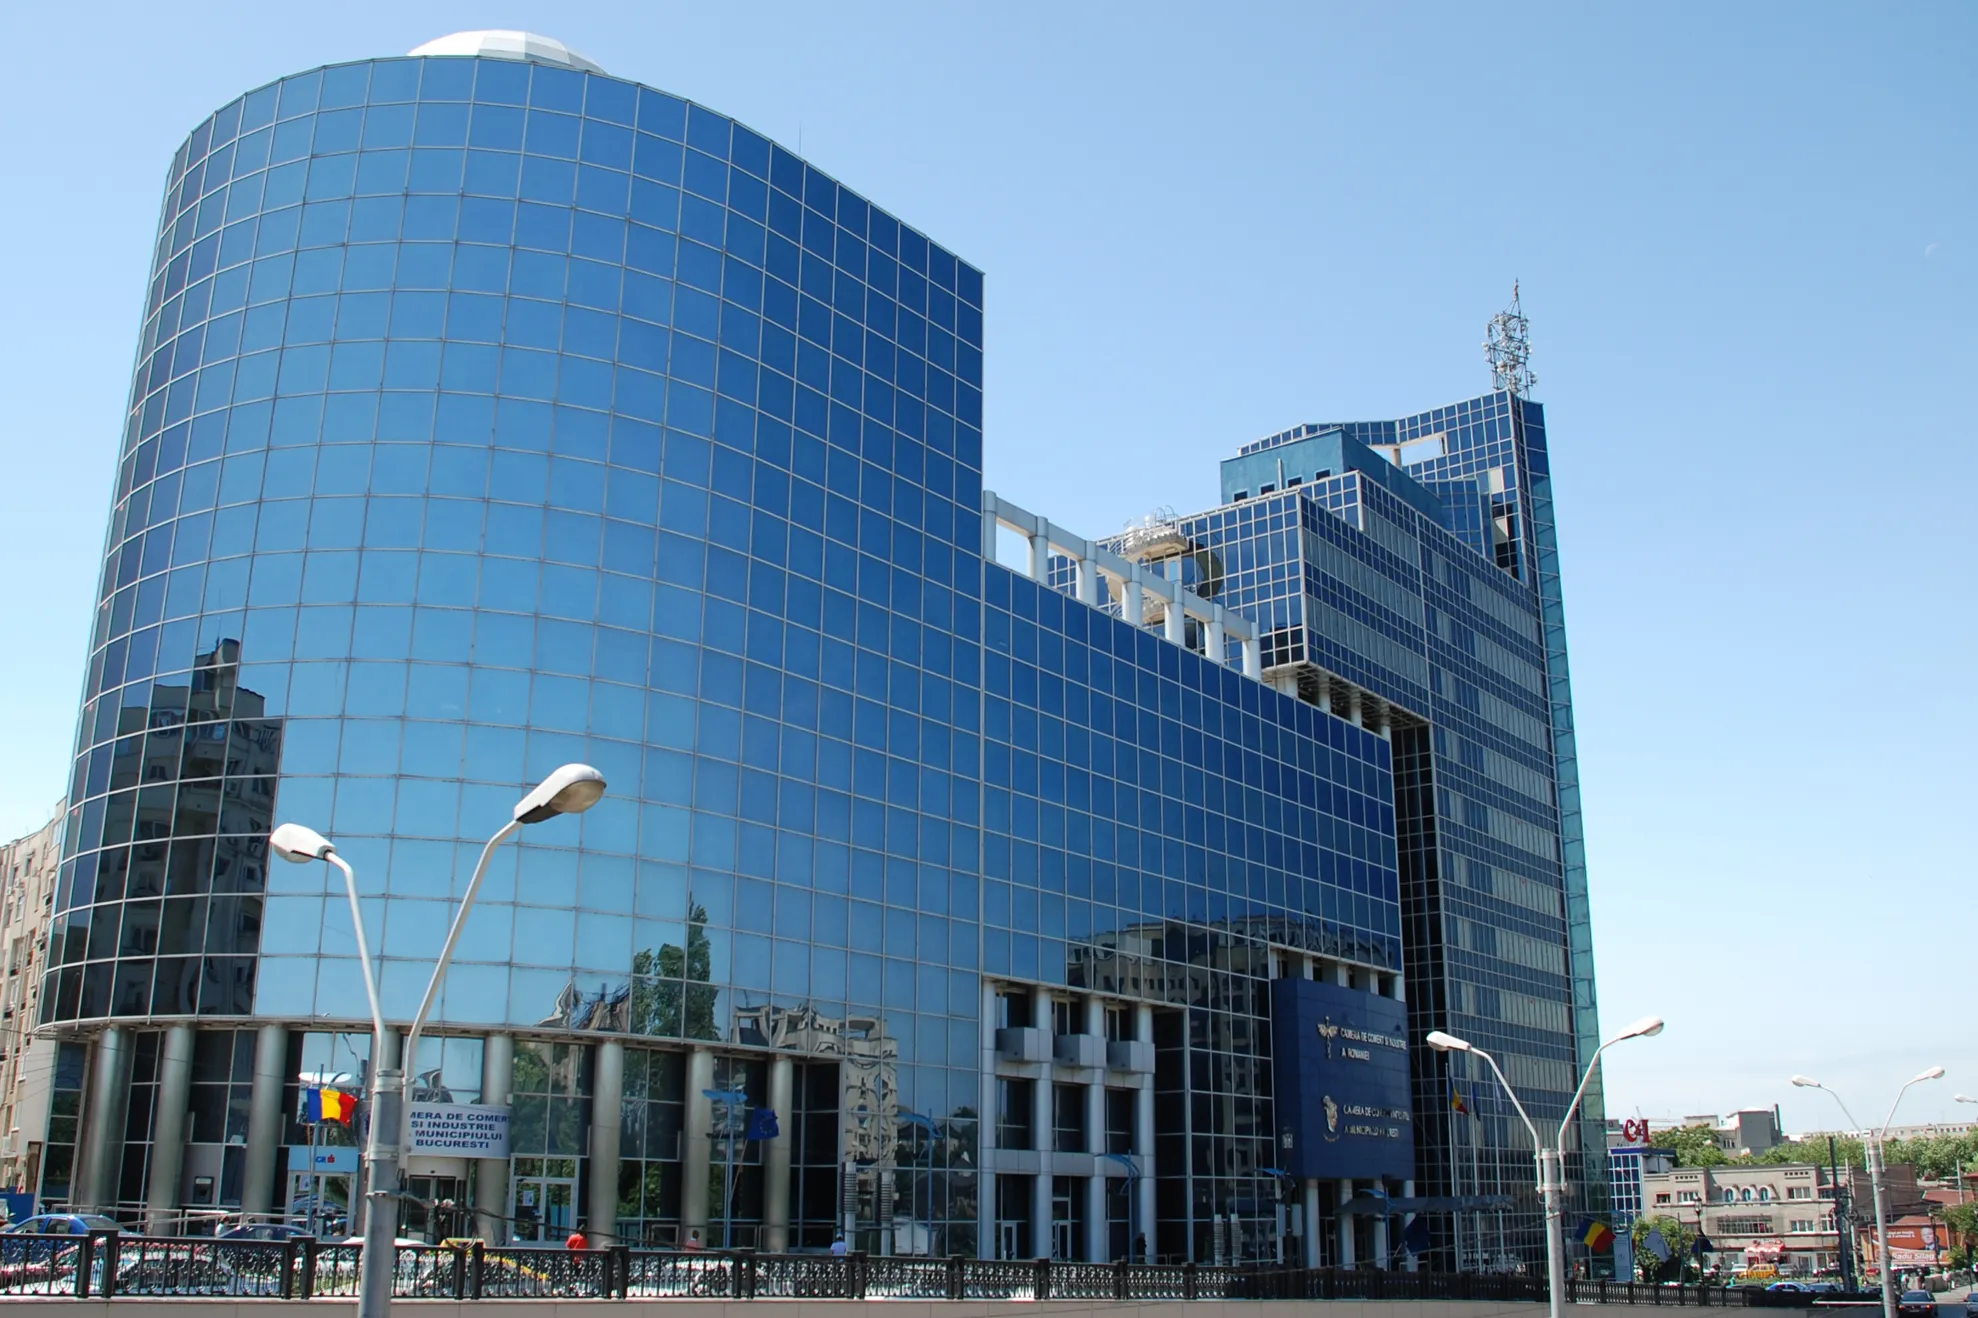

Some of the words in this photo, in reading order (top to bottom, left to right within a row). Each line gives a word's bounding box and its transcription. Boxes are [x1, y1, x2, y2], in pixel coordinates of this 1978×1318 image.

[447, 1113, 463, 1121] DE
[428, 1121, 496, 1131] INDUSTRIE
[416, 1130, 502, 1141] MUNICIPIULUI
[416, 1139, 489, 1149] BUCURESTI
